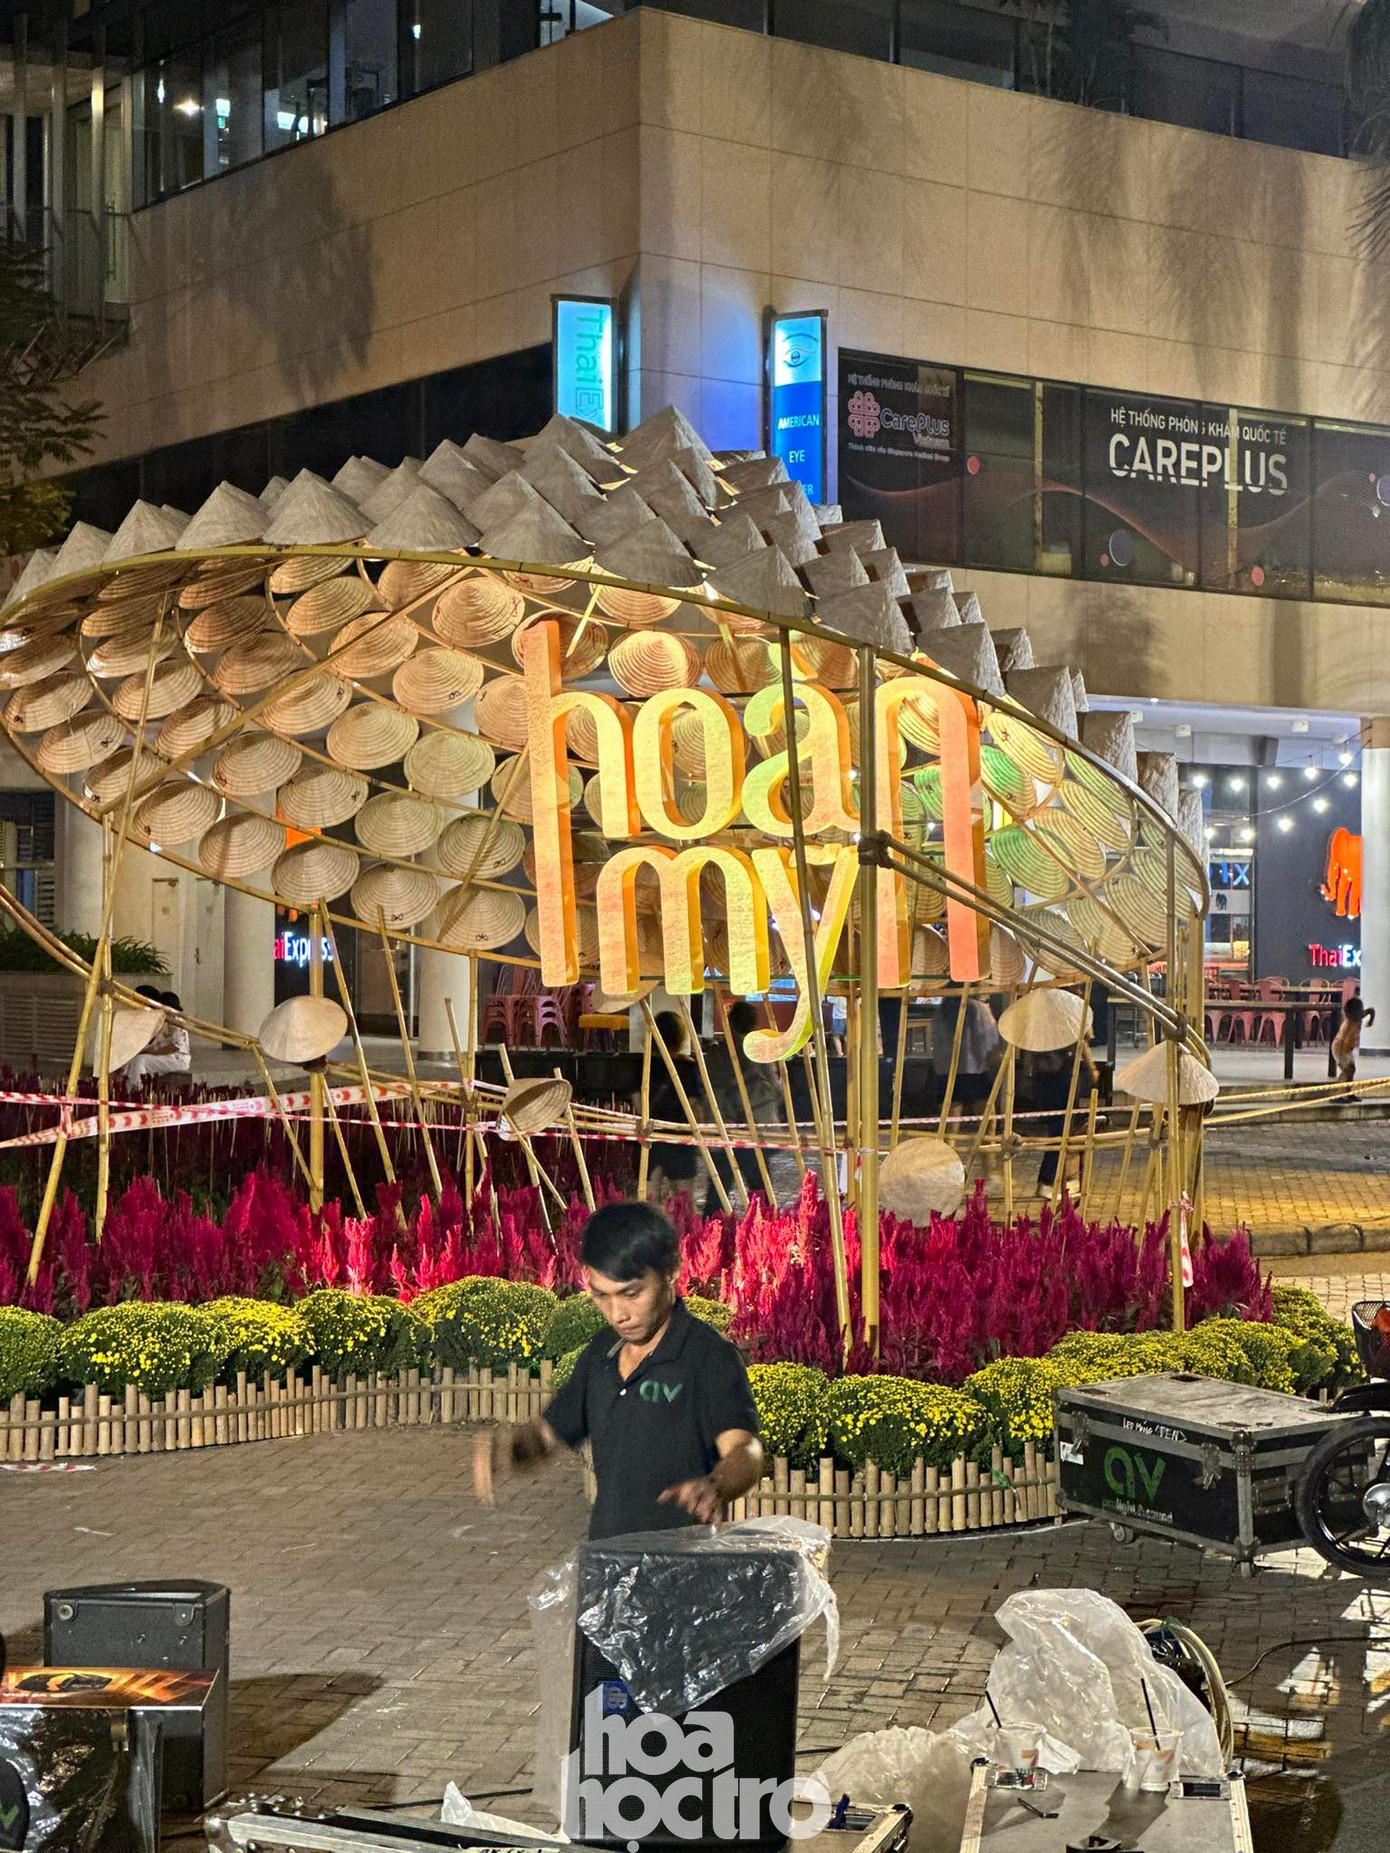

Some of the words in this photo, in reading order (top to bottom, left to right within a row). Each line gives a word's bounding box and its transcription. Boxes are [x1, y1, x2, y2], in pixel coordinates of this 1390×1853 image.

[778, 414, 820, 430] AMERICAN
[880, 407, 951, 437] CarePlus
[1110, 406, 1126, 428] HỆ
[1128, 407, 1166, 431] THỐNG
[1242, 424, 1271, 444] QUỐC
[789, 449, 806, 463] EYE
[1109, 432, 1288, 496] CAREPLUS
